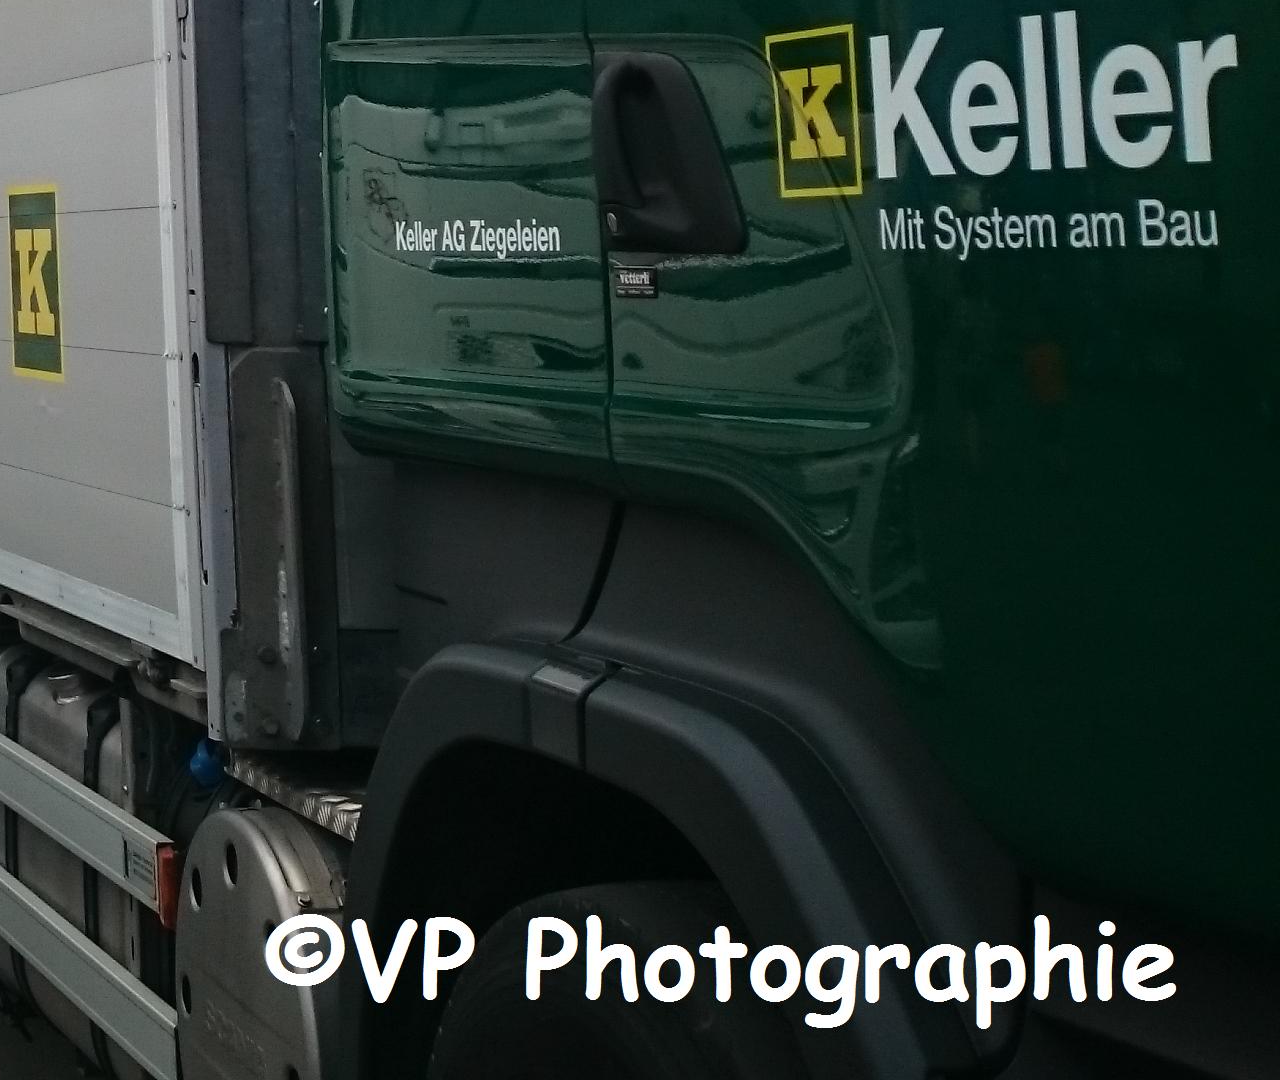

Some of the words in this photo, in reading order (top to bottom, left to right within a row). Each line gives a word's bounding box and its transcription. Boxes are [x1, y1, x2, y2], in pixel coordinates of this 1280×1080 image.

[780, 63, 847, 160] K
[869, 11, 1238, 179] Keller
[395, 221, 438, 251] Keller
[442, 220, 466, 251] AG
[470, 219, 561, 260] Ziegeleien
[878, 207, 927, 251] Mit
[934, 205, 1057, 261] System
[1069, 210, 1126, 248] am
[1138, 198, 1220, 248] Bau
[14, 228, 56, 337] K
